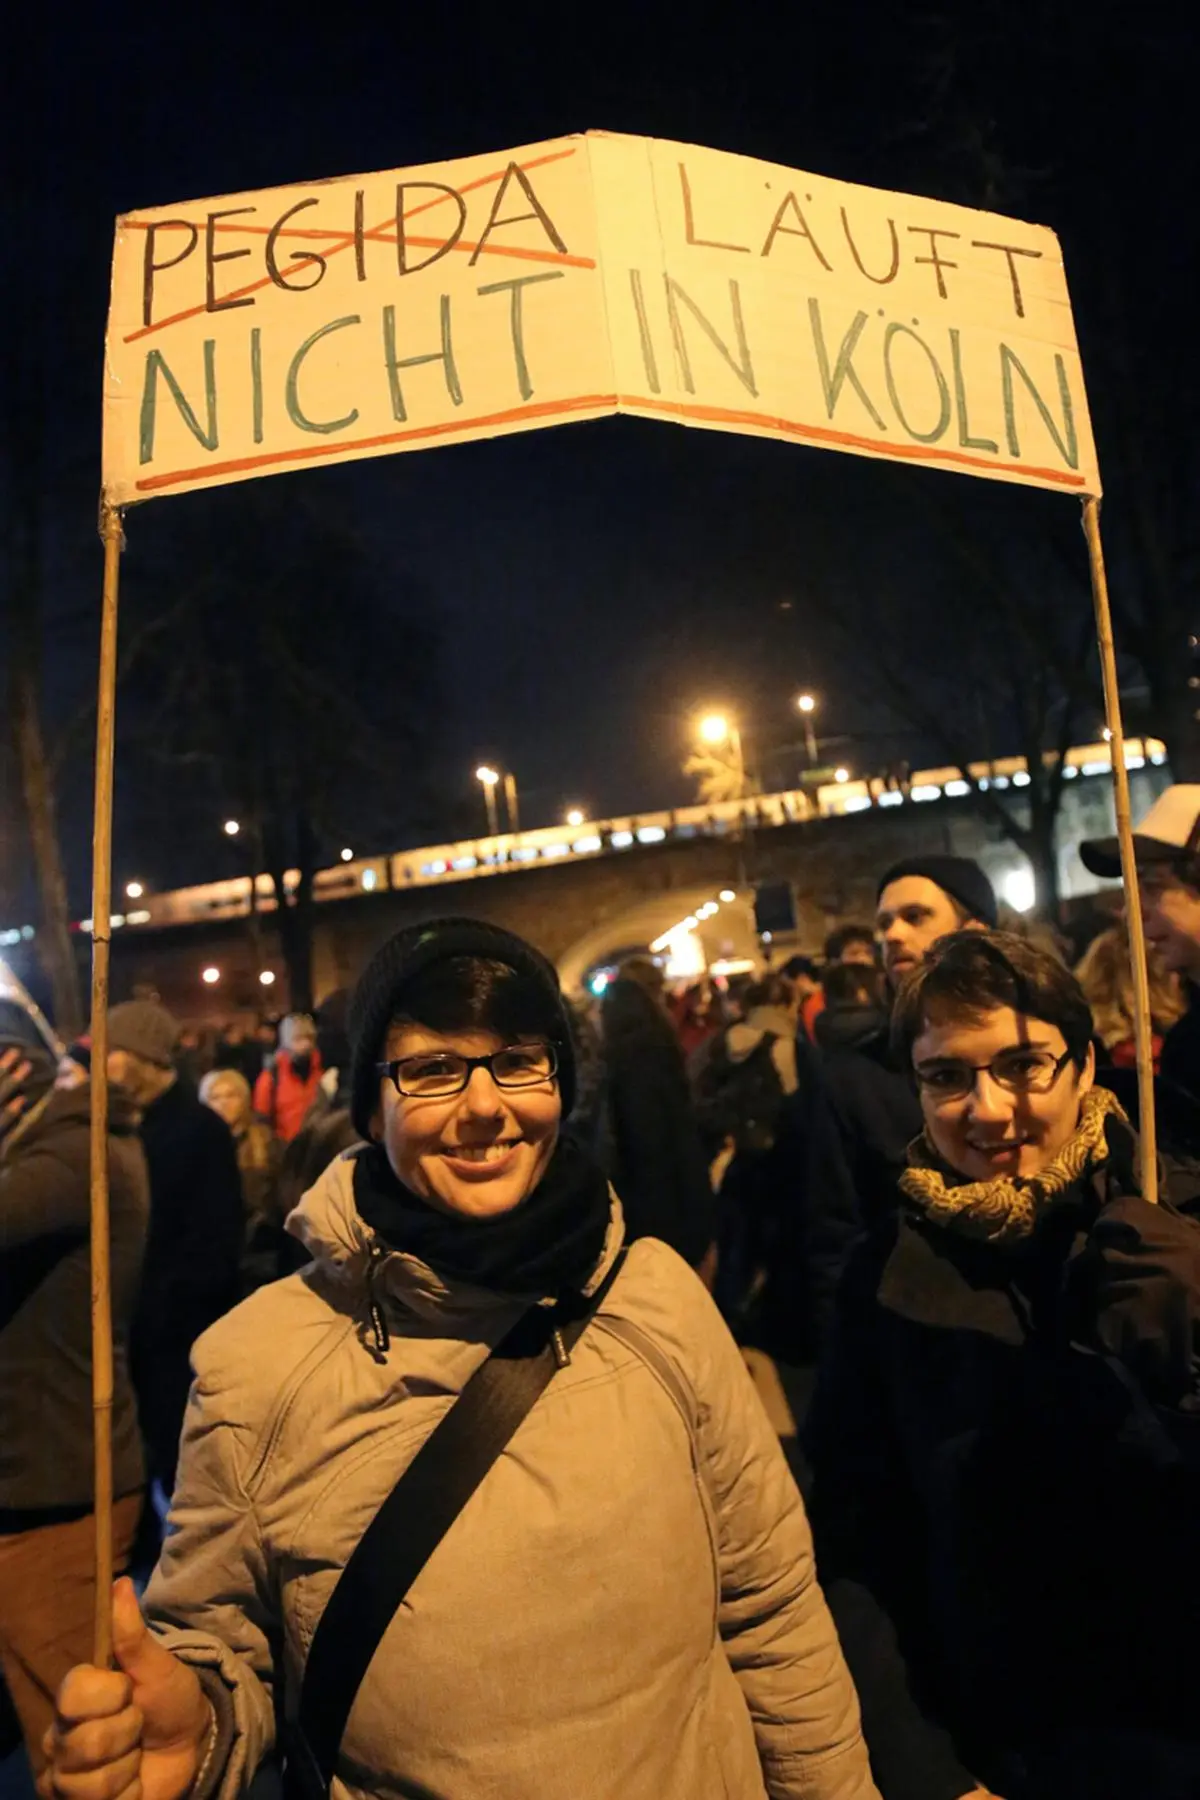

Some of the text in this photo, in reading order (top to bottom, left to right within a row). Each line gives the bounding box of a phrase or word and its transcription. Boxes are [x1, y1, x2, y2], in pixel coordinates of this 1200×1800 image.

[143, 161, 1043, 326] PEGIDA LÄUFT
[139, 268, 1079, 470] NICHT IN KÖLN
